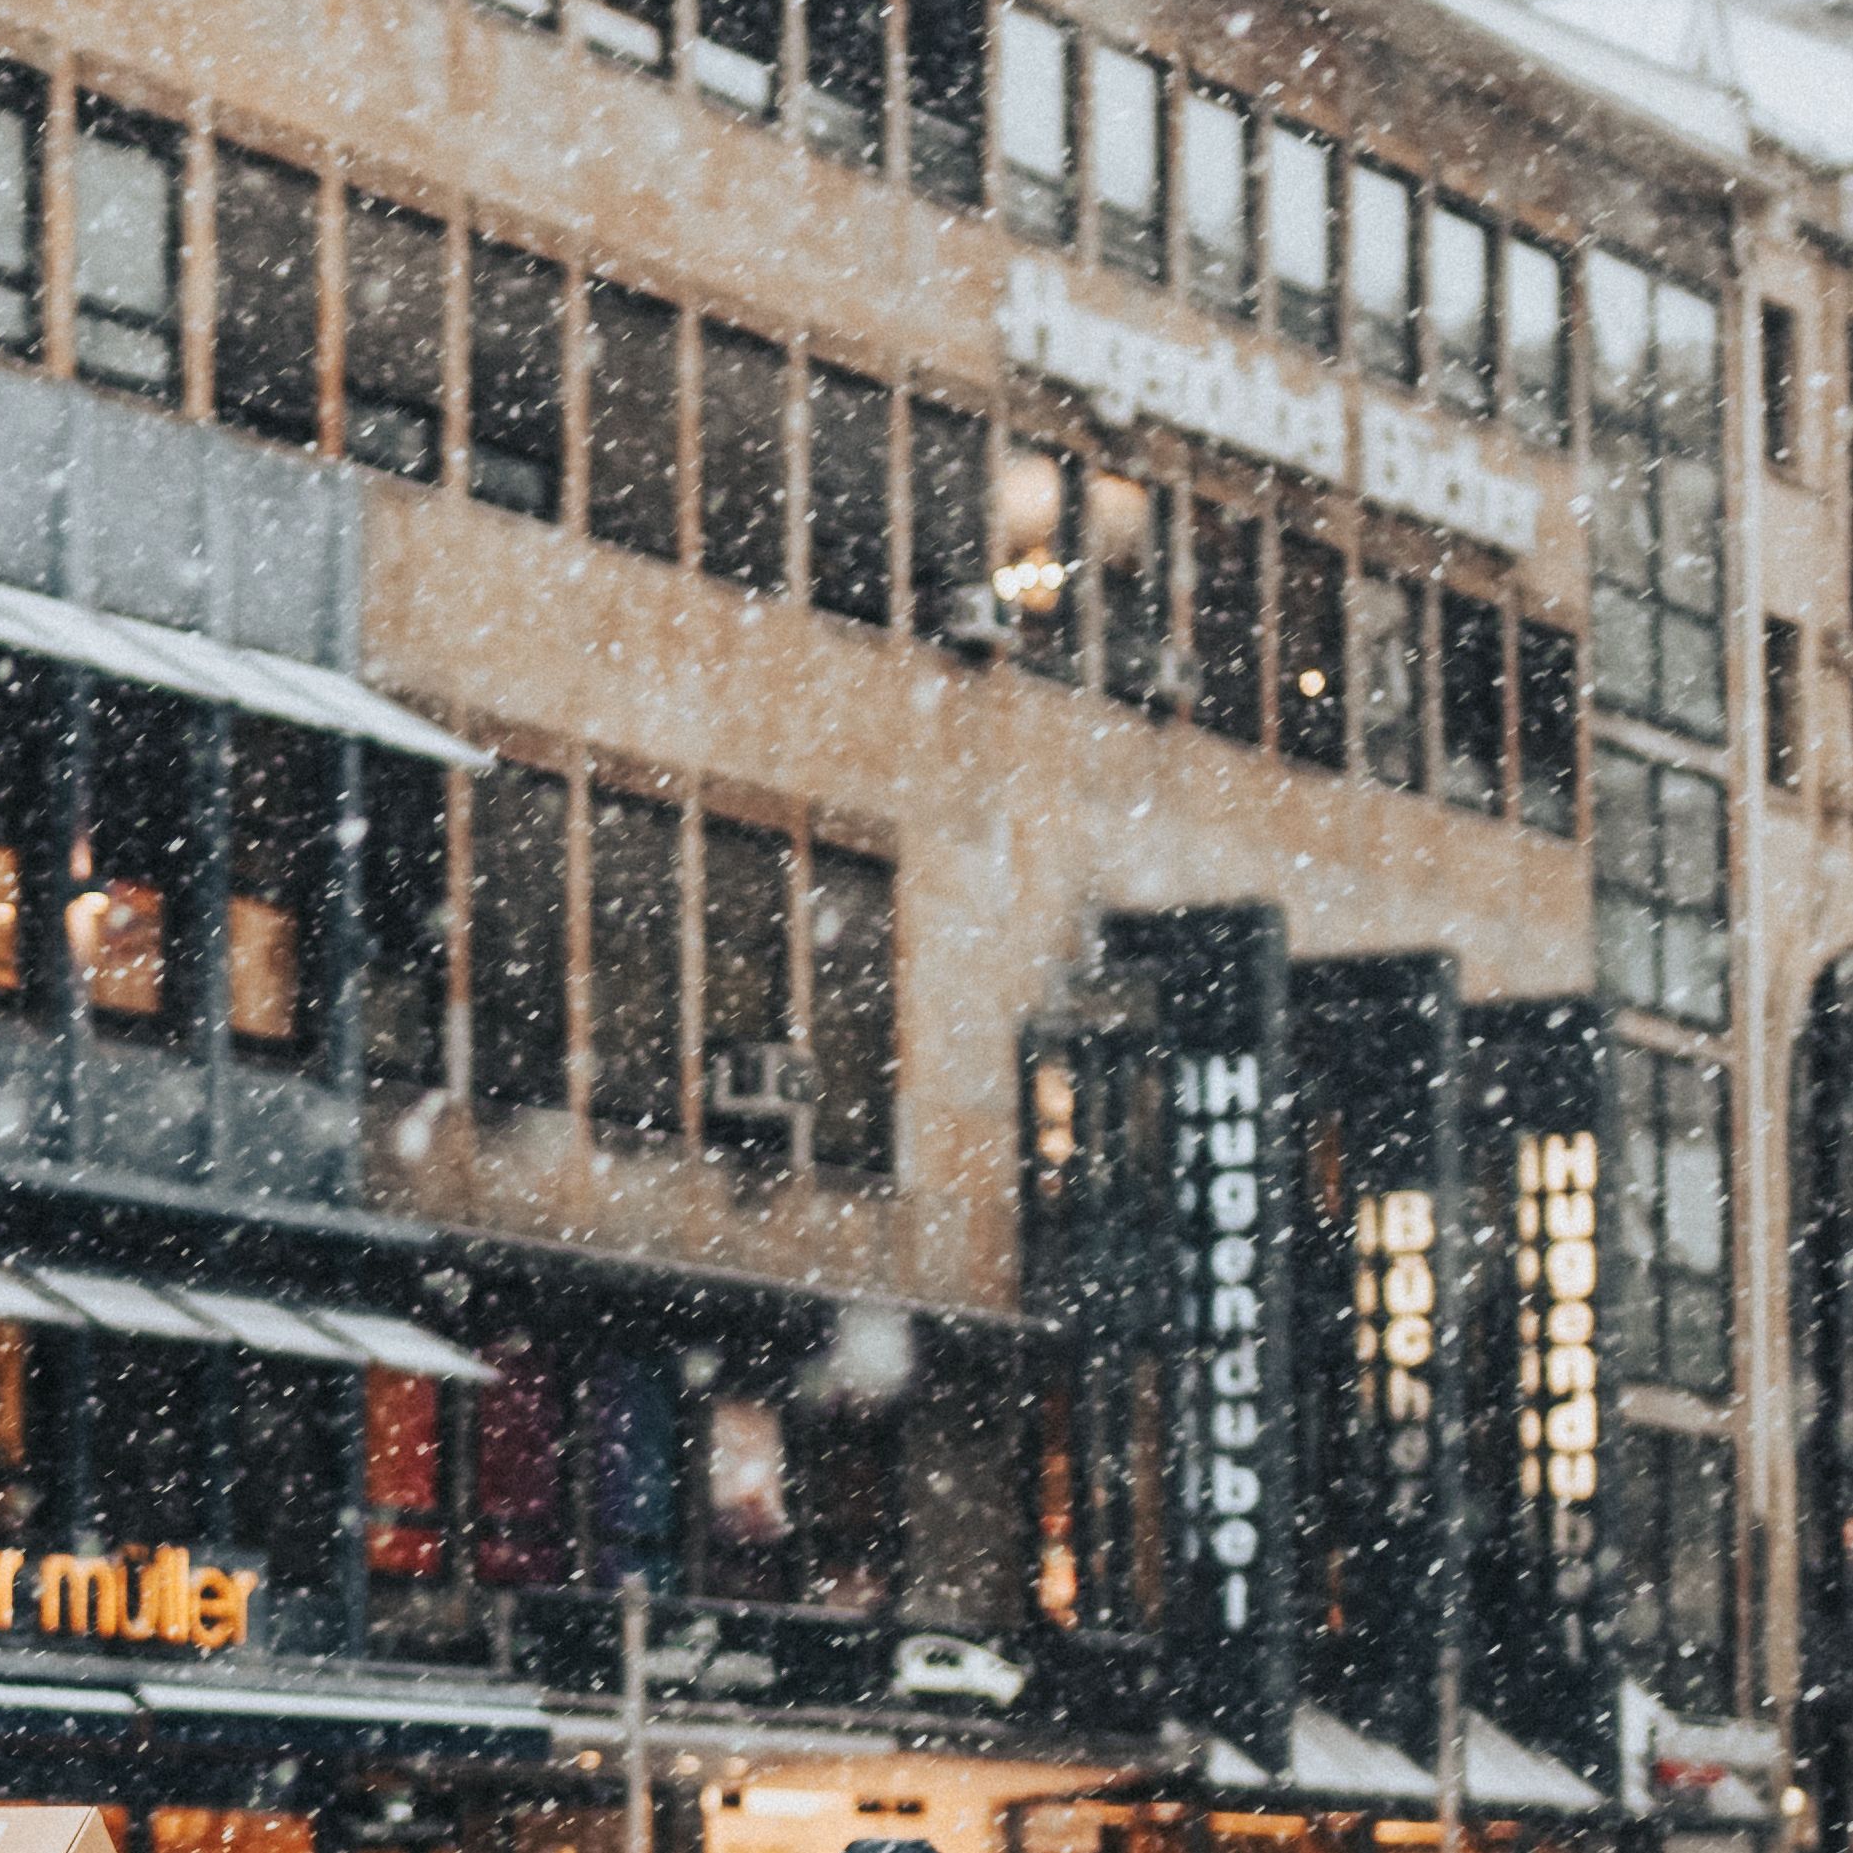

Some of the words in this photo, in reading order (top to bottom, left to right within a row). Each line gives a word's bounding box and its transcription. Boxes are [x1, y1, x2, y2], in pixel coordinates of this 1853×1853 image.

[41, 1544, 260, 1648] müller
[1209, 1053, 1259, 1631] Hugendubel
[1543, 1131, 1597, 1664] Hugendubel
